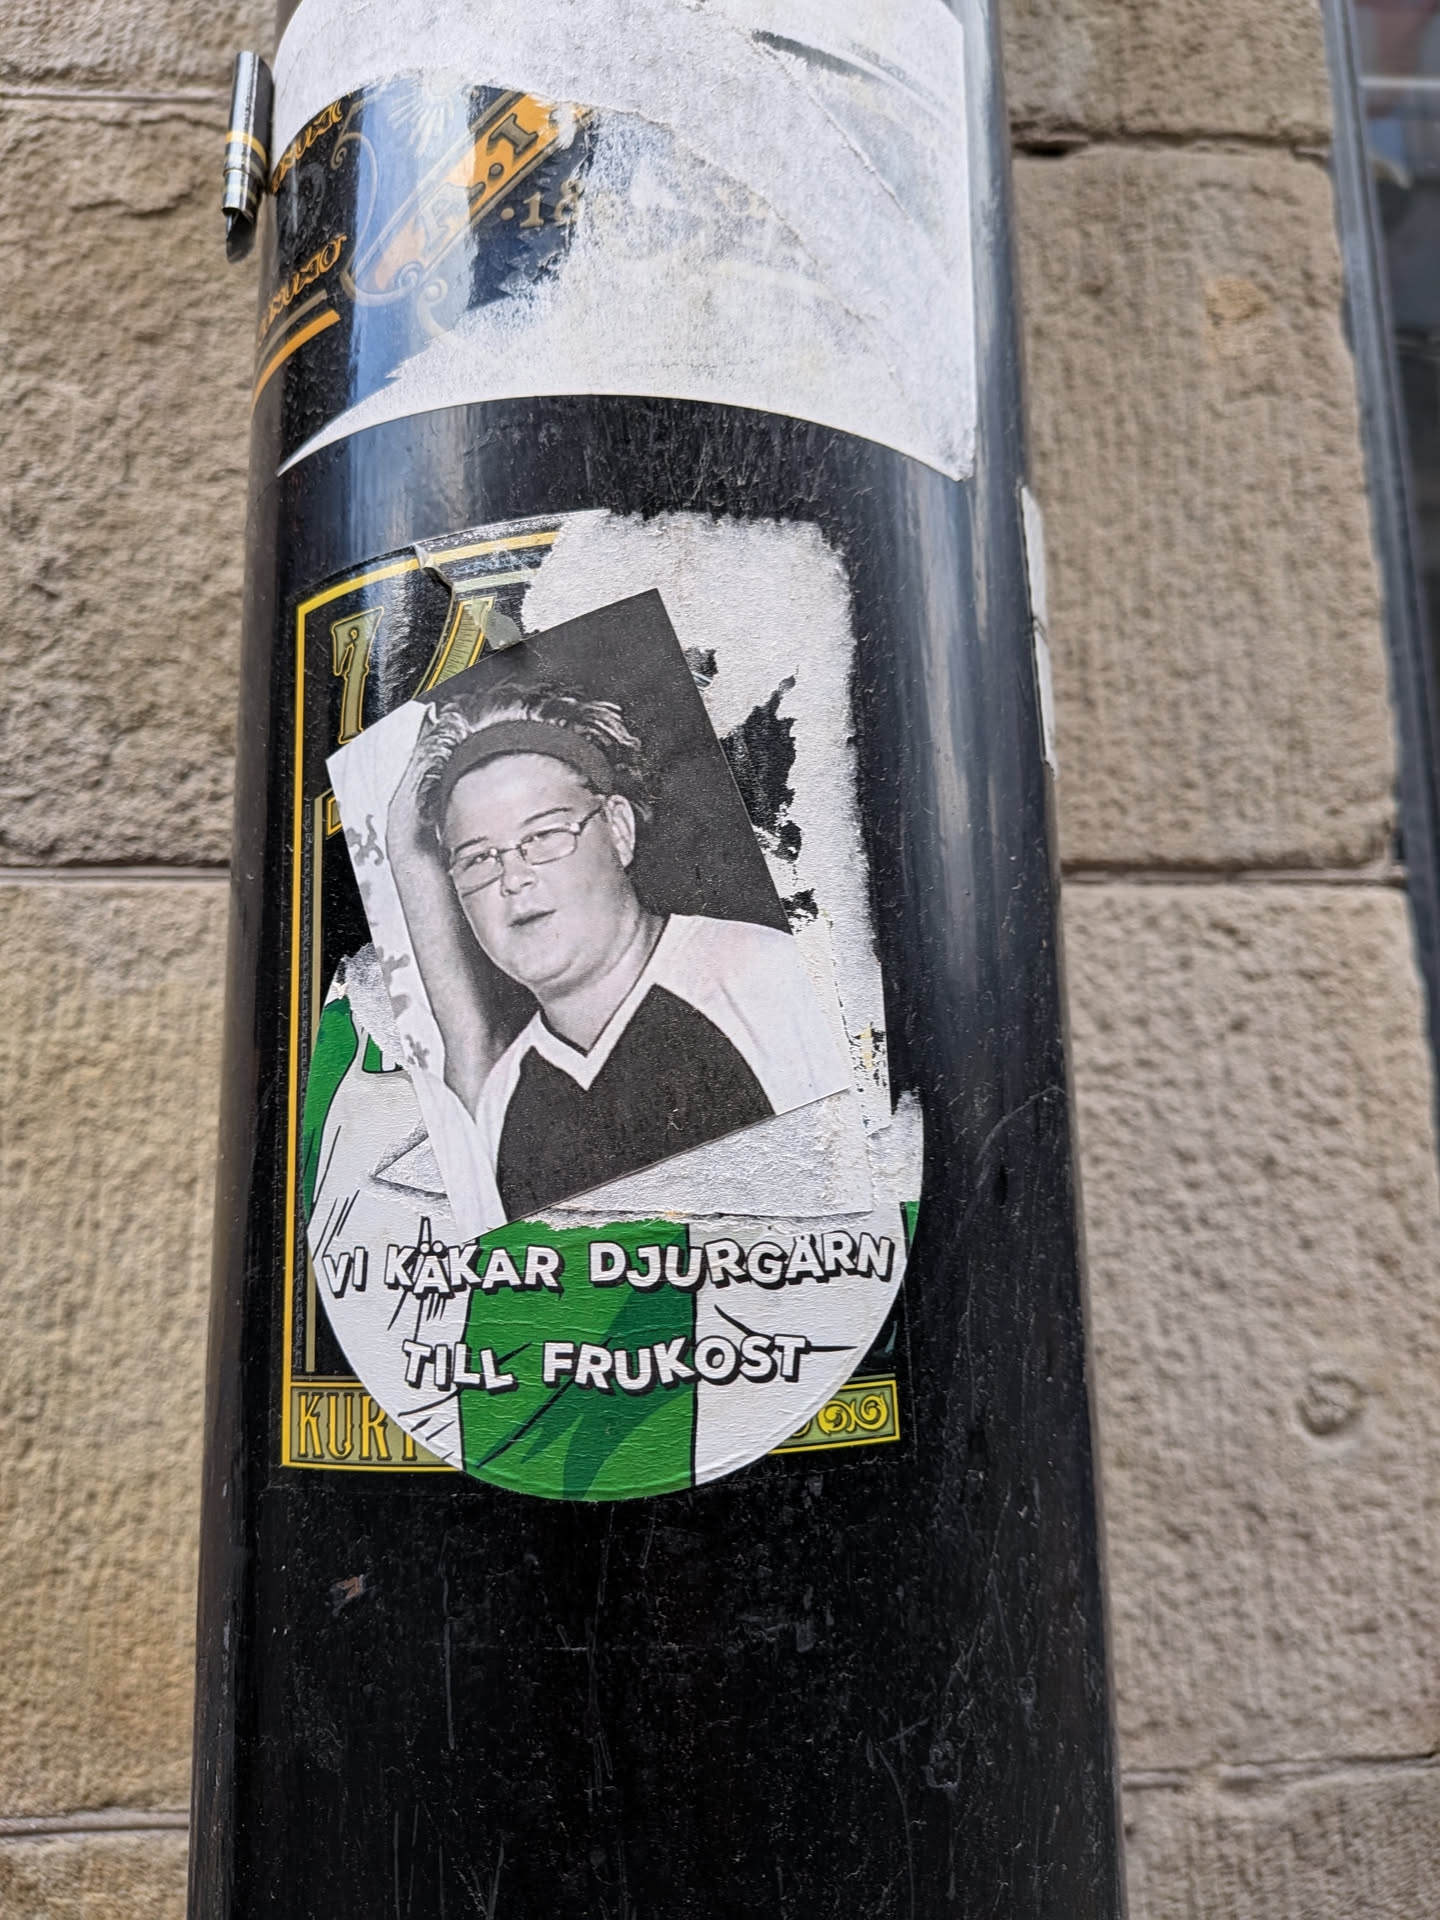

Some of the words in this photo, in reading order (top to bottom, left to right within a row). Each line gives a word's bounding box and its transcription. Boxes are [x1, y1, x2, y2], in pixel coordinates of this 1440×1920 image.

[322, 1246, 368, 1298] VI
[384, 1240, 565, 1299] KÄKAR
[589, 1231, 896, 1292] DJURGÅRN
[402, 1338, 518, 1394] TILL
[542, 1333, 812, 1396] FRUKOST
